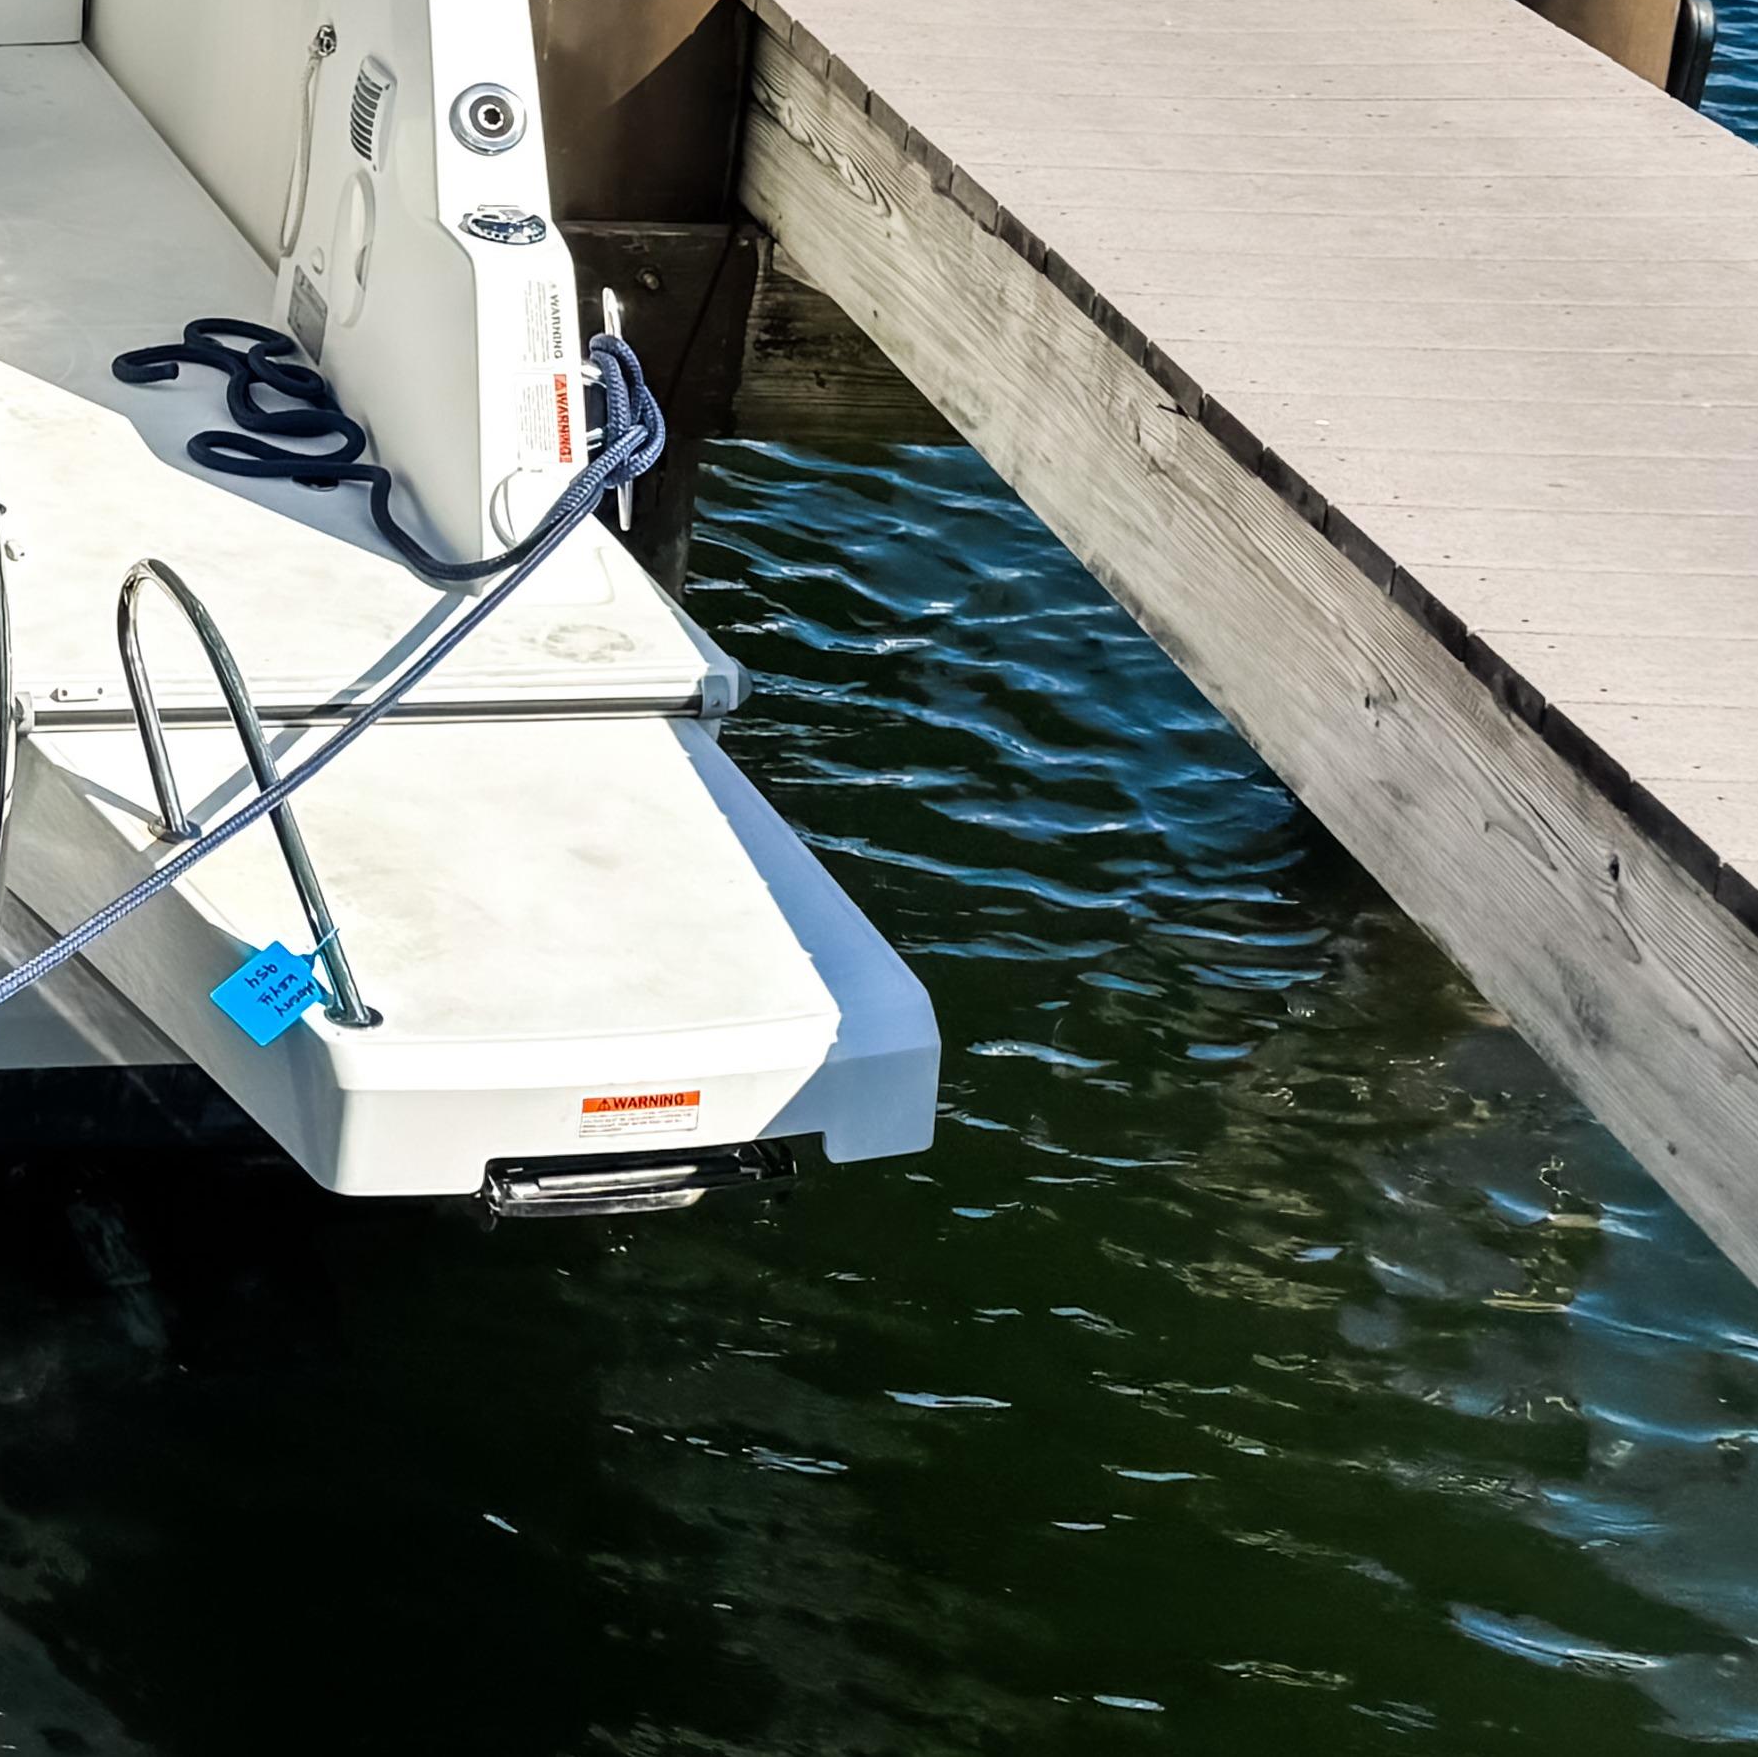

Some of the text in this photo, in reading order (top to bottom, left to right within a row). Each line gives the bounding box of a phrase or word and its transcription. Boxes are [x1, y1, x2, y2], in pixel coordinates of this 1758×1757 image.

[550, 294, 563, 359] WARNING
[556, 393, 572, 456] WARNING
[613, 1093, 685, 1109] WARNING
